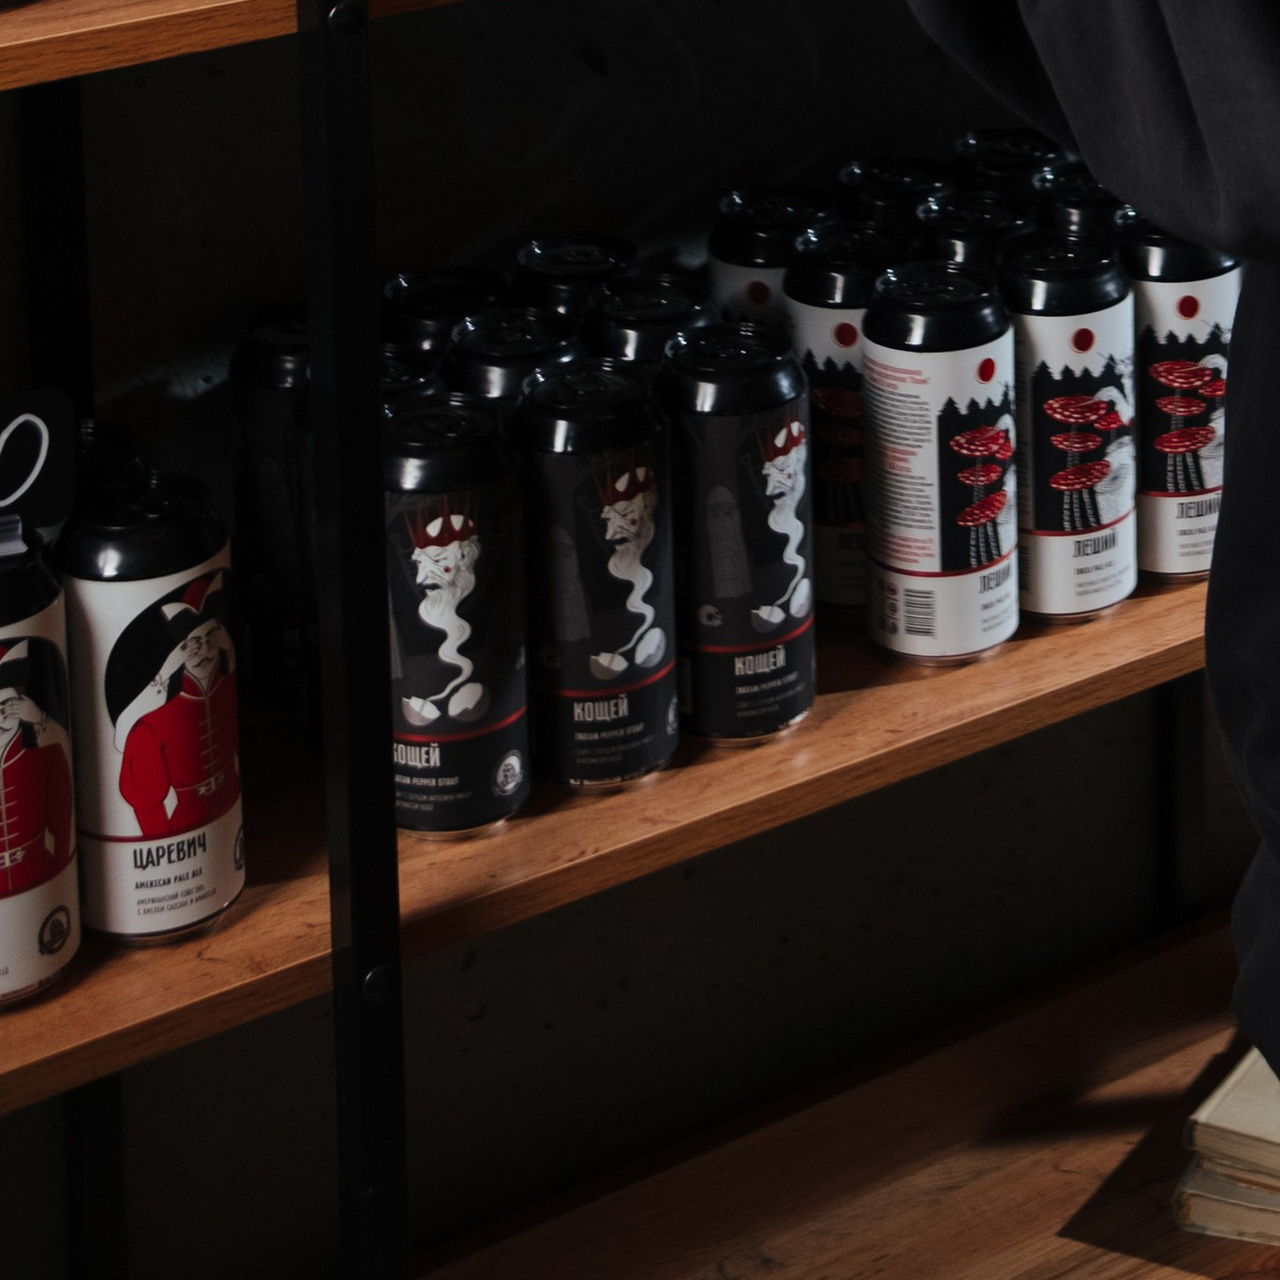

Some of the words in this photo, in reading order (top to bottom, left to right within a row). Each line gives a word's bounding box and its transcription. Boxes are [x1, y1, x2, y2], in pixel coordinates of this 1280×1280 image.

[734, 644, 787, 676] КОЩЕЙ
[573, 693, 630, 722] КОЩЕЙ
[133, 831, 208, 871] ЦАРЕВИЧ
[134, 876, 172, 890] AMERICAN
[173, 871, 190, 884] PALE
